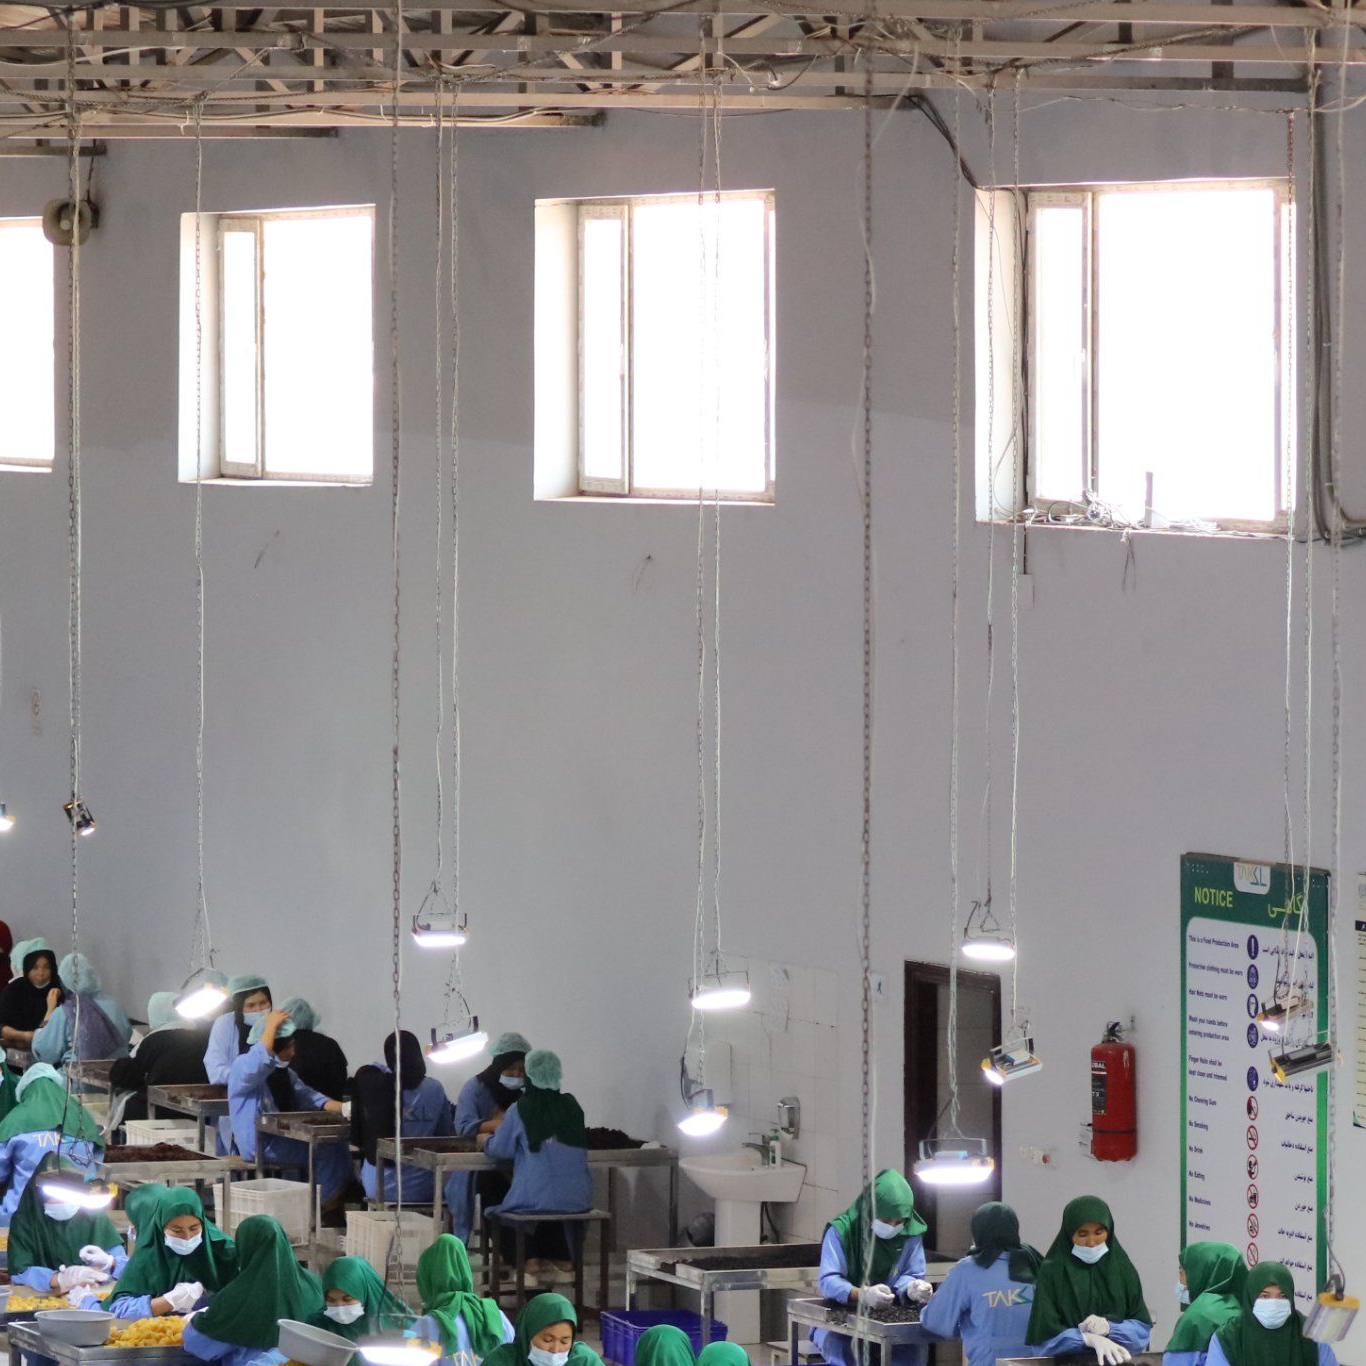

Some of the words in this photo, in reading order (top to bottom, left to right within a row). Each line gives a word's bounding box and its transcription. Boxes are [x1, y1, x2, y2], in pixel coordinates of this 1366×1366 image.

[1194, 887, 1234, 908] NOTICE
[1268, 892, 1309, 918] گاهی
[1188, 934, 1196, 943] This
[1203, 937, 1212, 945] Food
[1212, 938, 1230, 947] Production
[1230, 941, 1239, 949] Area
[1206, 964, 1220, 975] clothing
[1220, 967, 1229, 975] must
[1205, 991, 1214, 999] must
[1216, 1019, 1228, 1028] before
[1188, 1029, 1203, 1039] entering
[1203, 1031, 1221, 1040] production
[1221, 1034, 1230, 1042] area
[1188, 1055, 1199, 1064] Finger
[1199, 1057, 1208, 1065] Nails
[1208, 1058, 1217, 1066] shall
[1188, 1094, 1193, 1102] No
[1193, 1096, 1208, 1106] Chewing
[1208, 1098, 1217, 1106] Gum
[1193, 1121, 1208, 1131] Smoking
[1193, 1146, 1203, 1154] Drink
[1194, 1171, 1205, 1181] Eating
